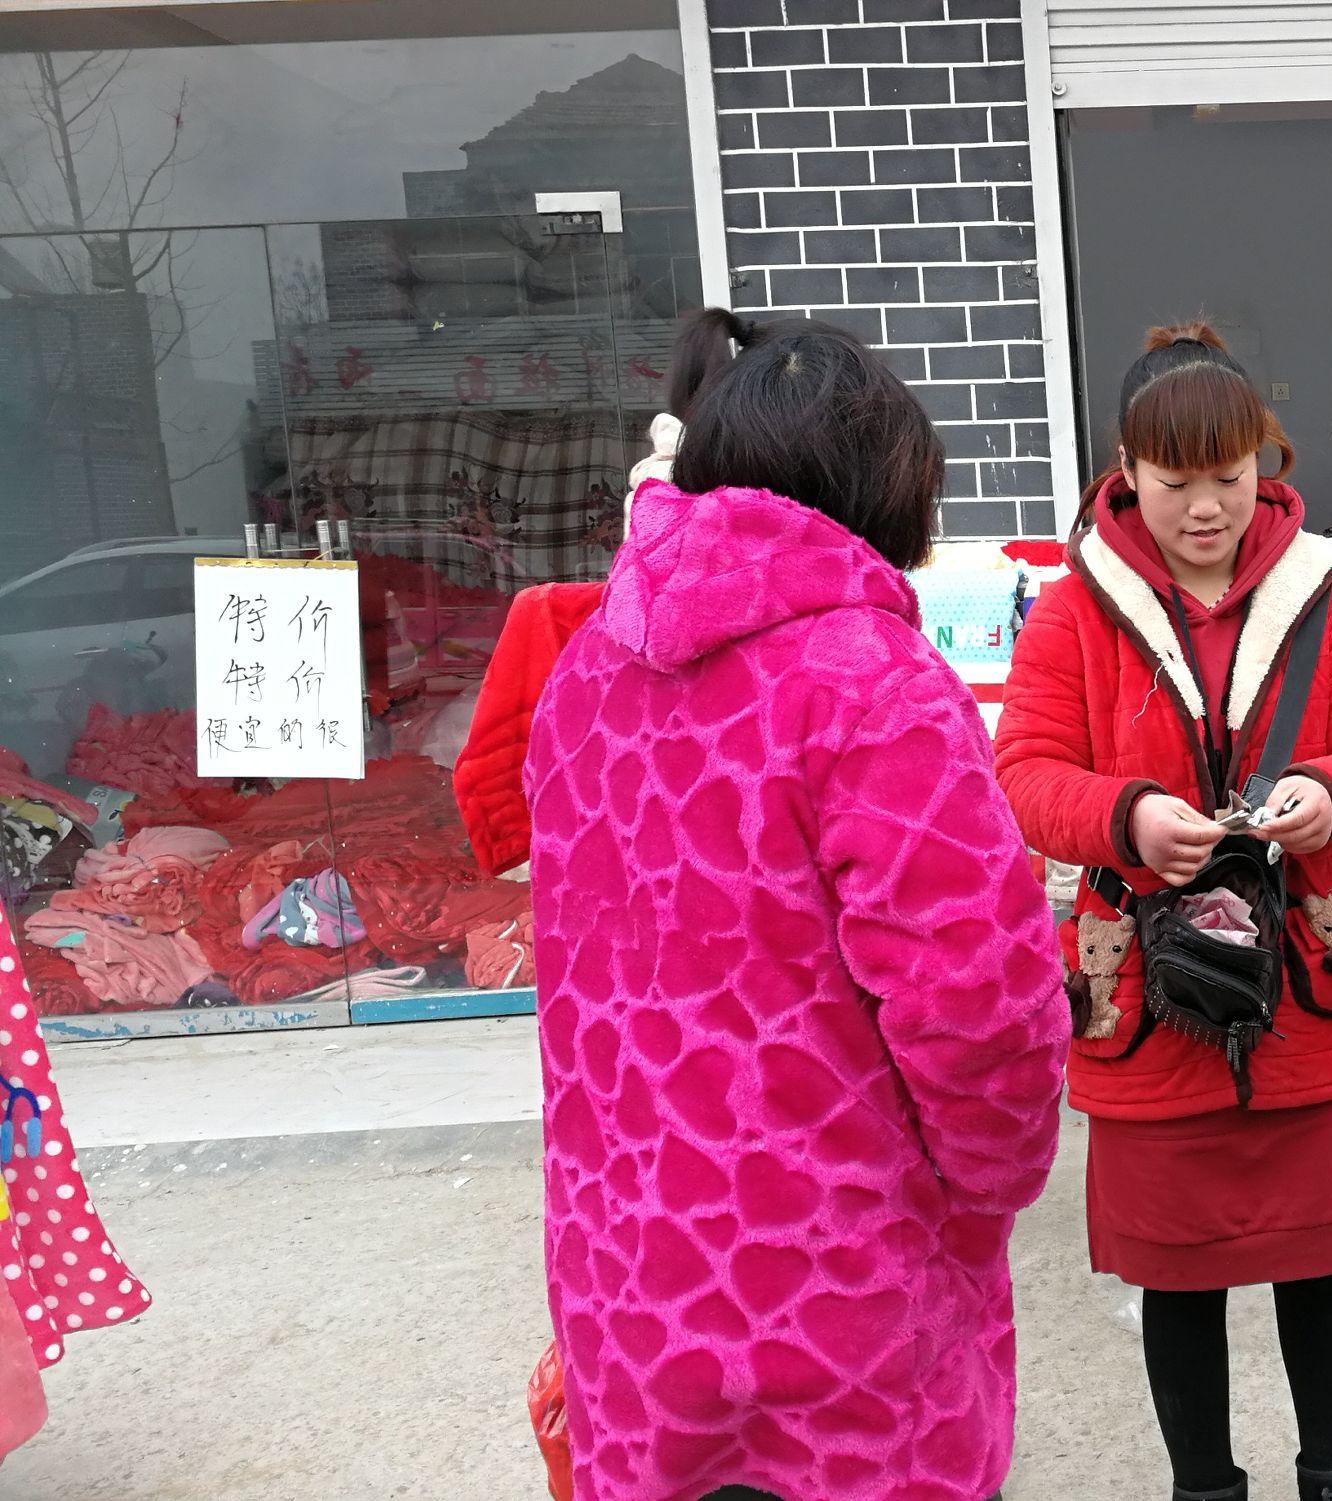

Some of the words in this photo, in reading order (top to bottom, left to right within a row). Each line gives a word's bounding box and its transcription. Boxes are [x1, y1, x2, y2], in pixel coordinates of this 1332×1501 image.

[218, 594, 333, 668] 特价
[222, 659, 326, 718] 特价
[201, 715, 348, 759] 便宜的很
